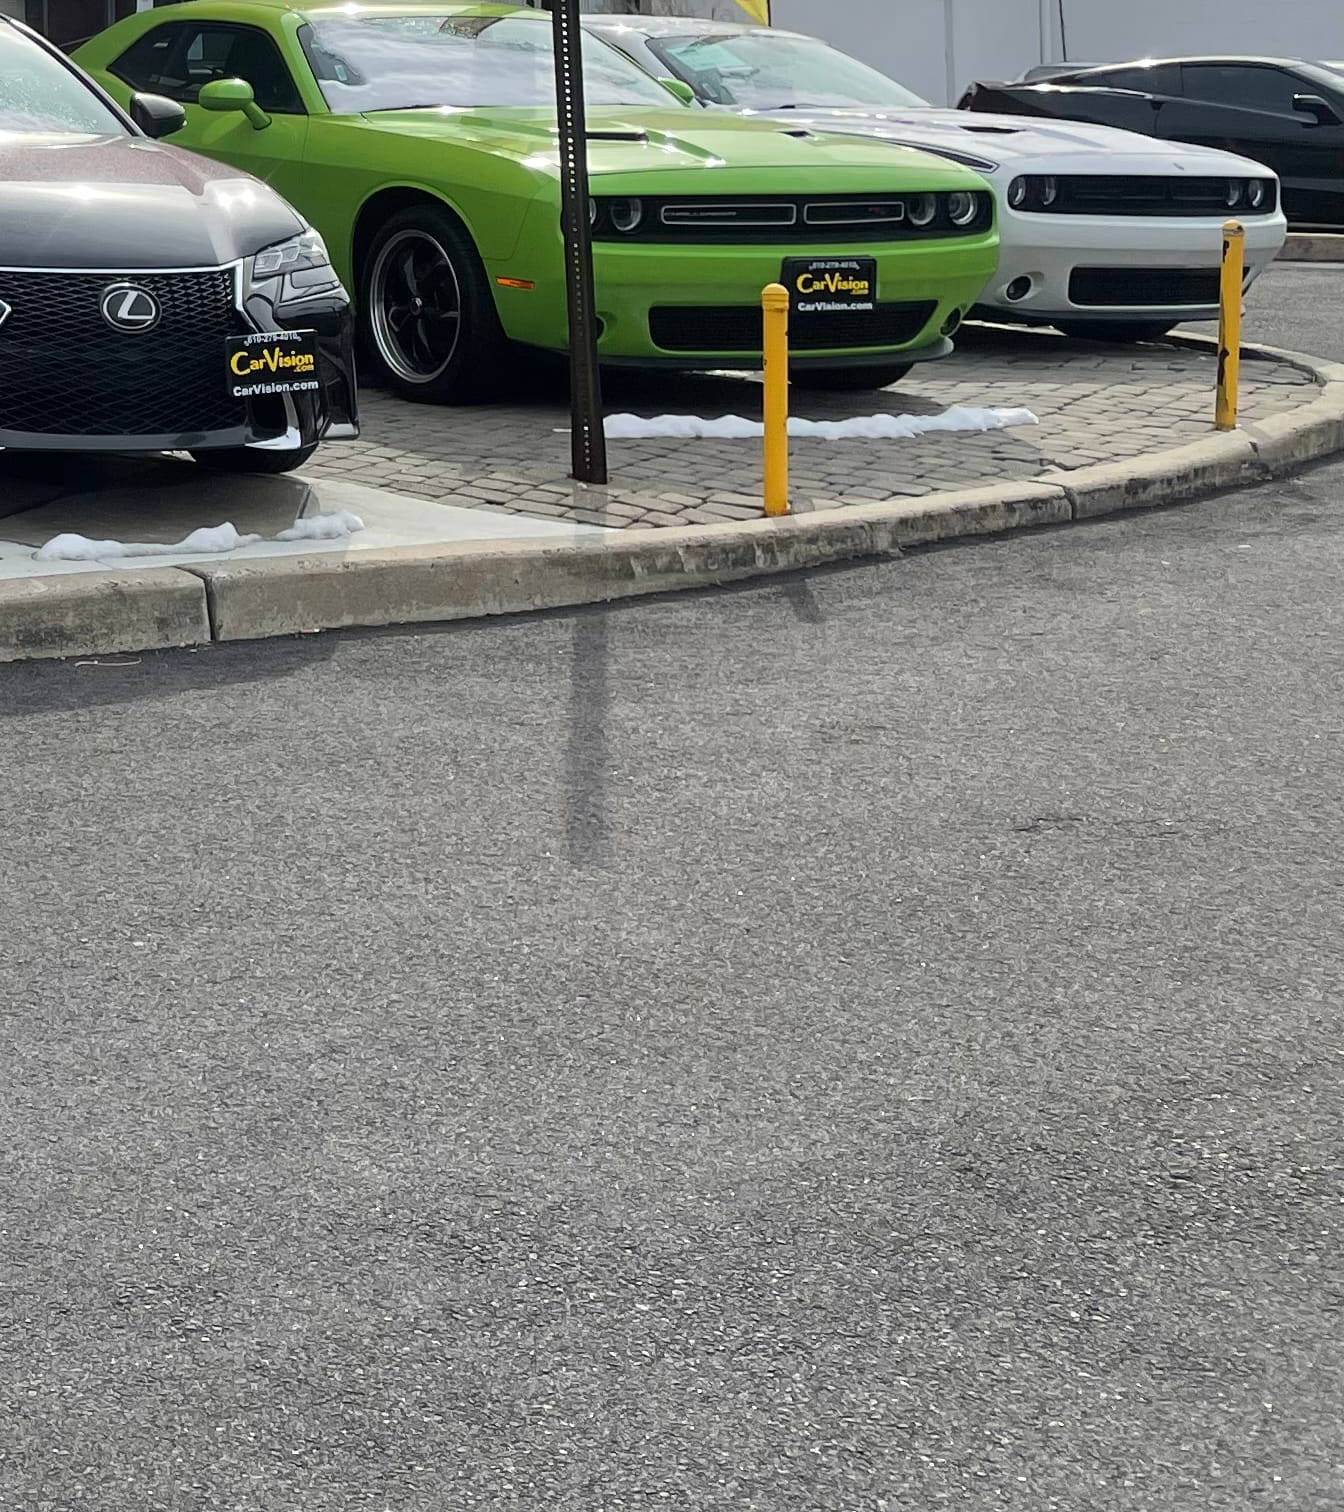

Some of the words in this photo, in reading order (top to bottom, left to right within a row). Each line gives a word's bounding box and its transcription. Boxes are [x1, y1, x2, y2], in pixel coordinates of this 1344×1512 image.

[796, 272, 870, 294] CarVision
[230, 347, 315, 376] CarVision
[232, 380, 320, 397] CarVision.com
